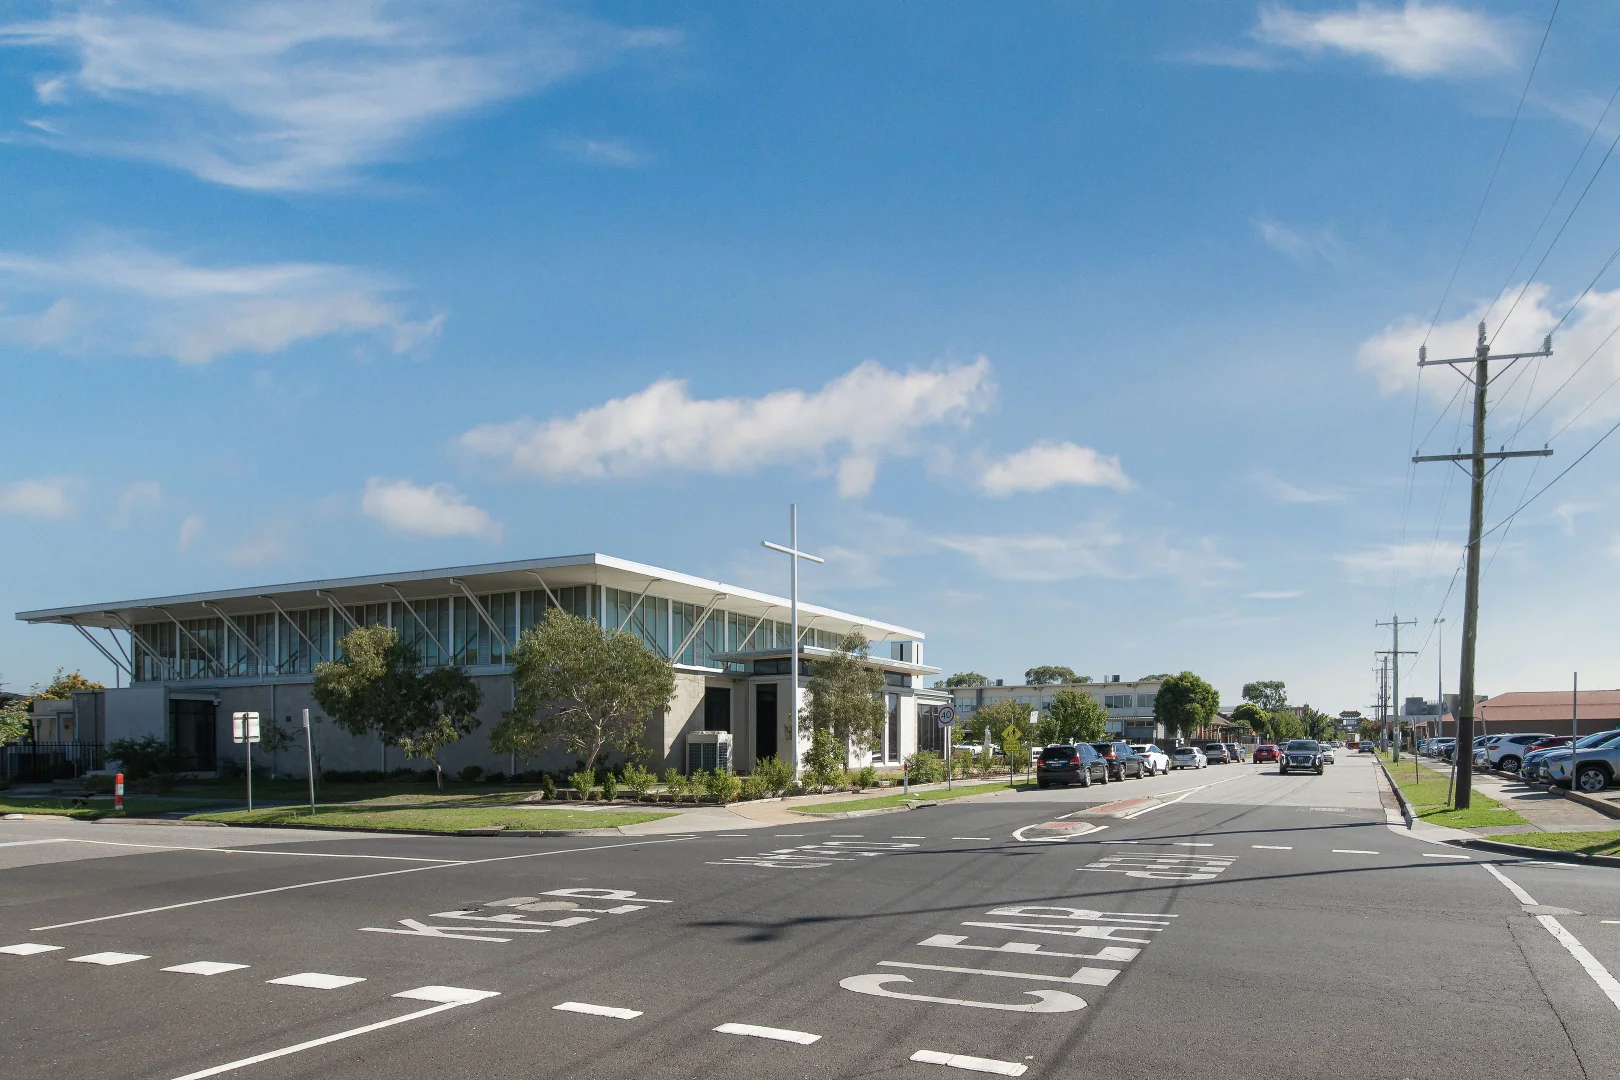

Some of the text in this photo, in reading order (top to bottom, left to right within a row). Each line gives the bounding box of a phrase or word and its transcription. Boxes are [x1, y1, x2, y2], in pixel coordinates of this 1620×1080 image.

[941, 711, 951, 719] 40
[1075, 851, 1240, 879] KEEP
[839, 905, 1179, 1013] CLEAR
